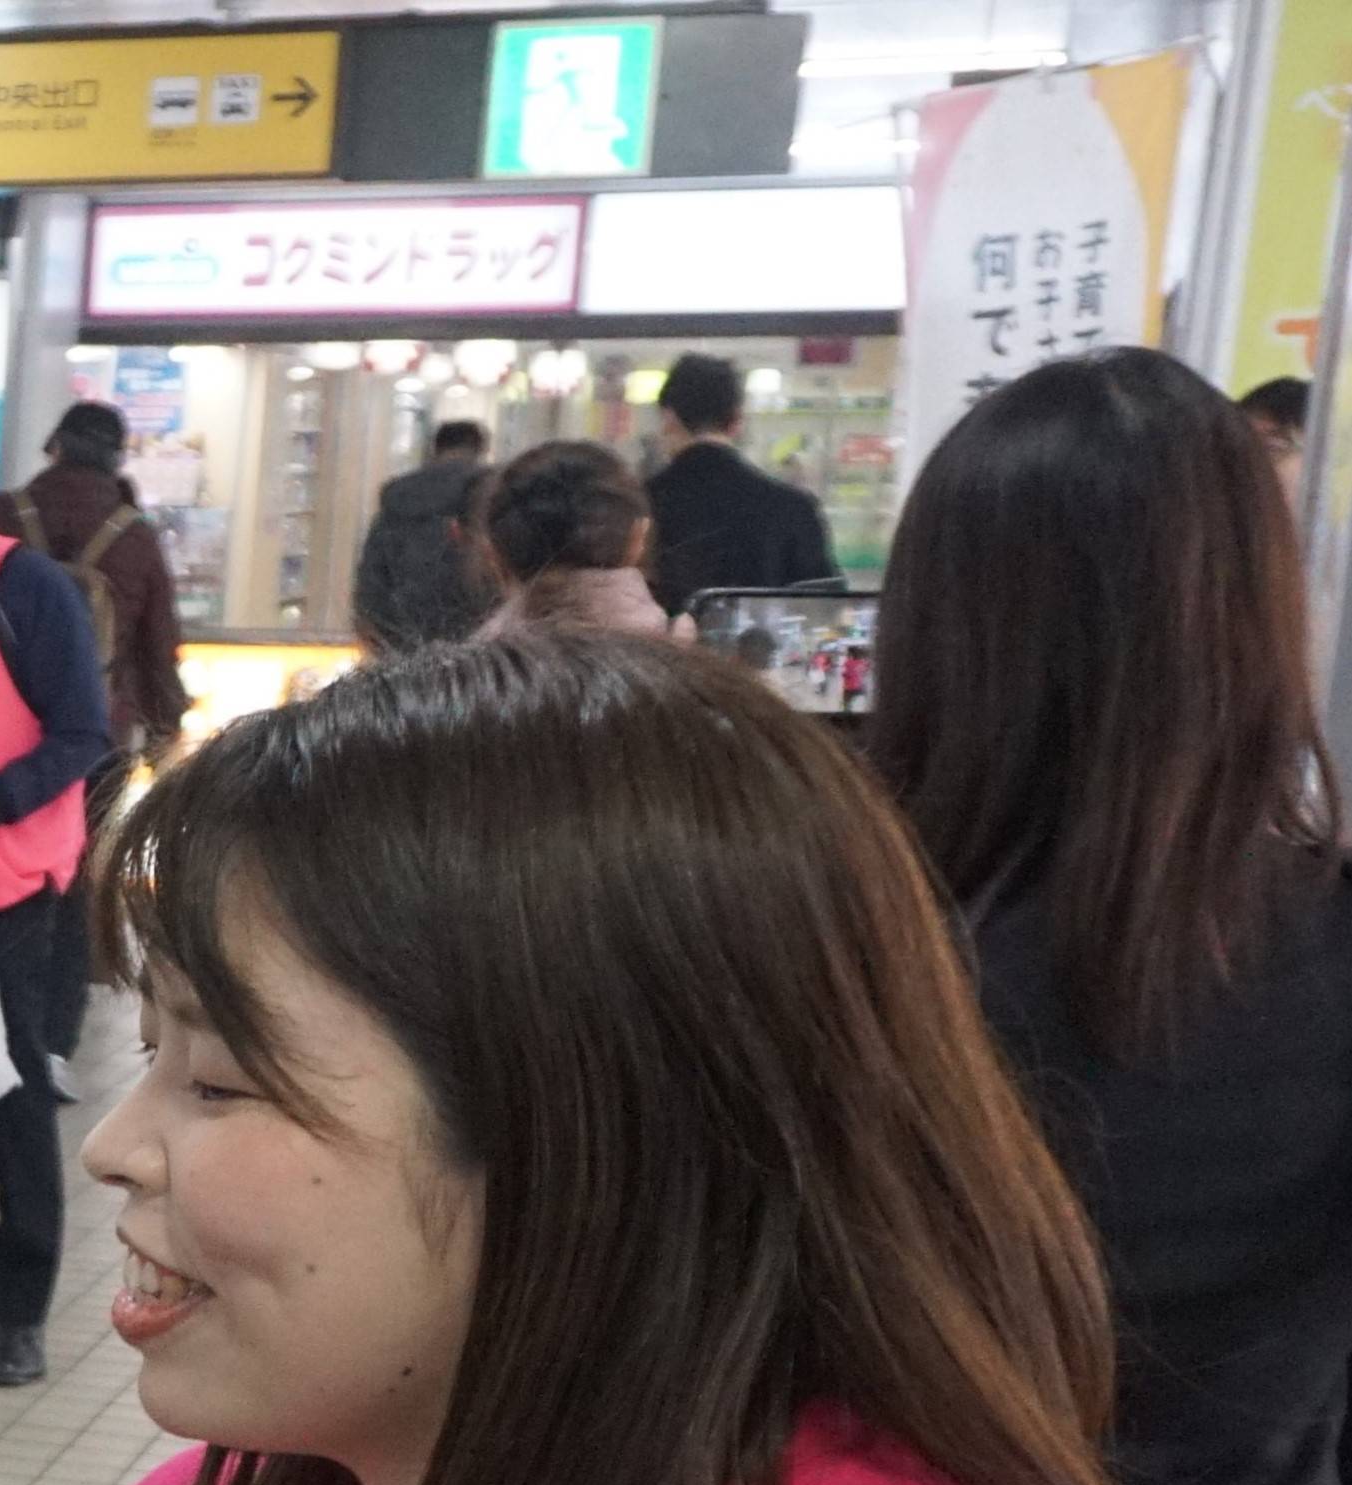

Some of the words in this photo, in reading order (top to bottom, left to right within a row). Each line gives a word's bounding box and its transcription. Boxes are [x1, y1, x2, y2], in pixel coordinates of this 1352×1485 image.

[242, 231, 565, 288] コクミンドラッグ
